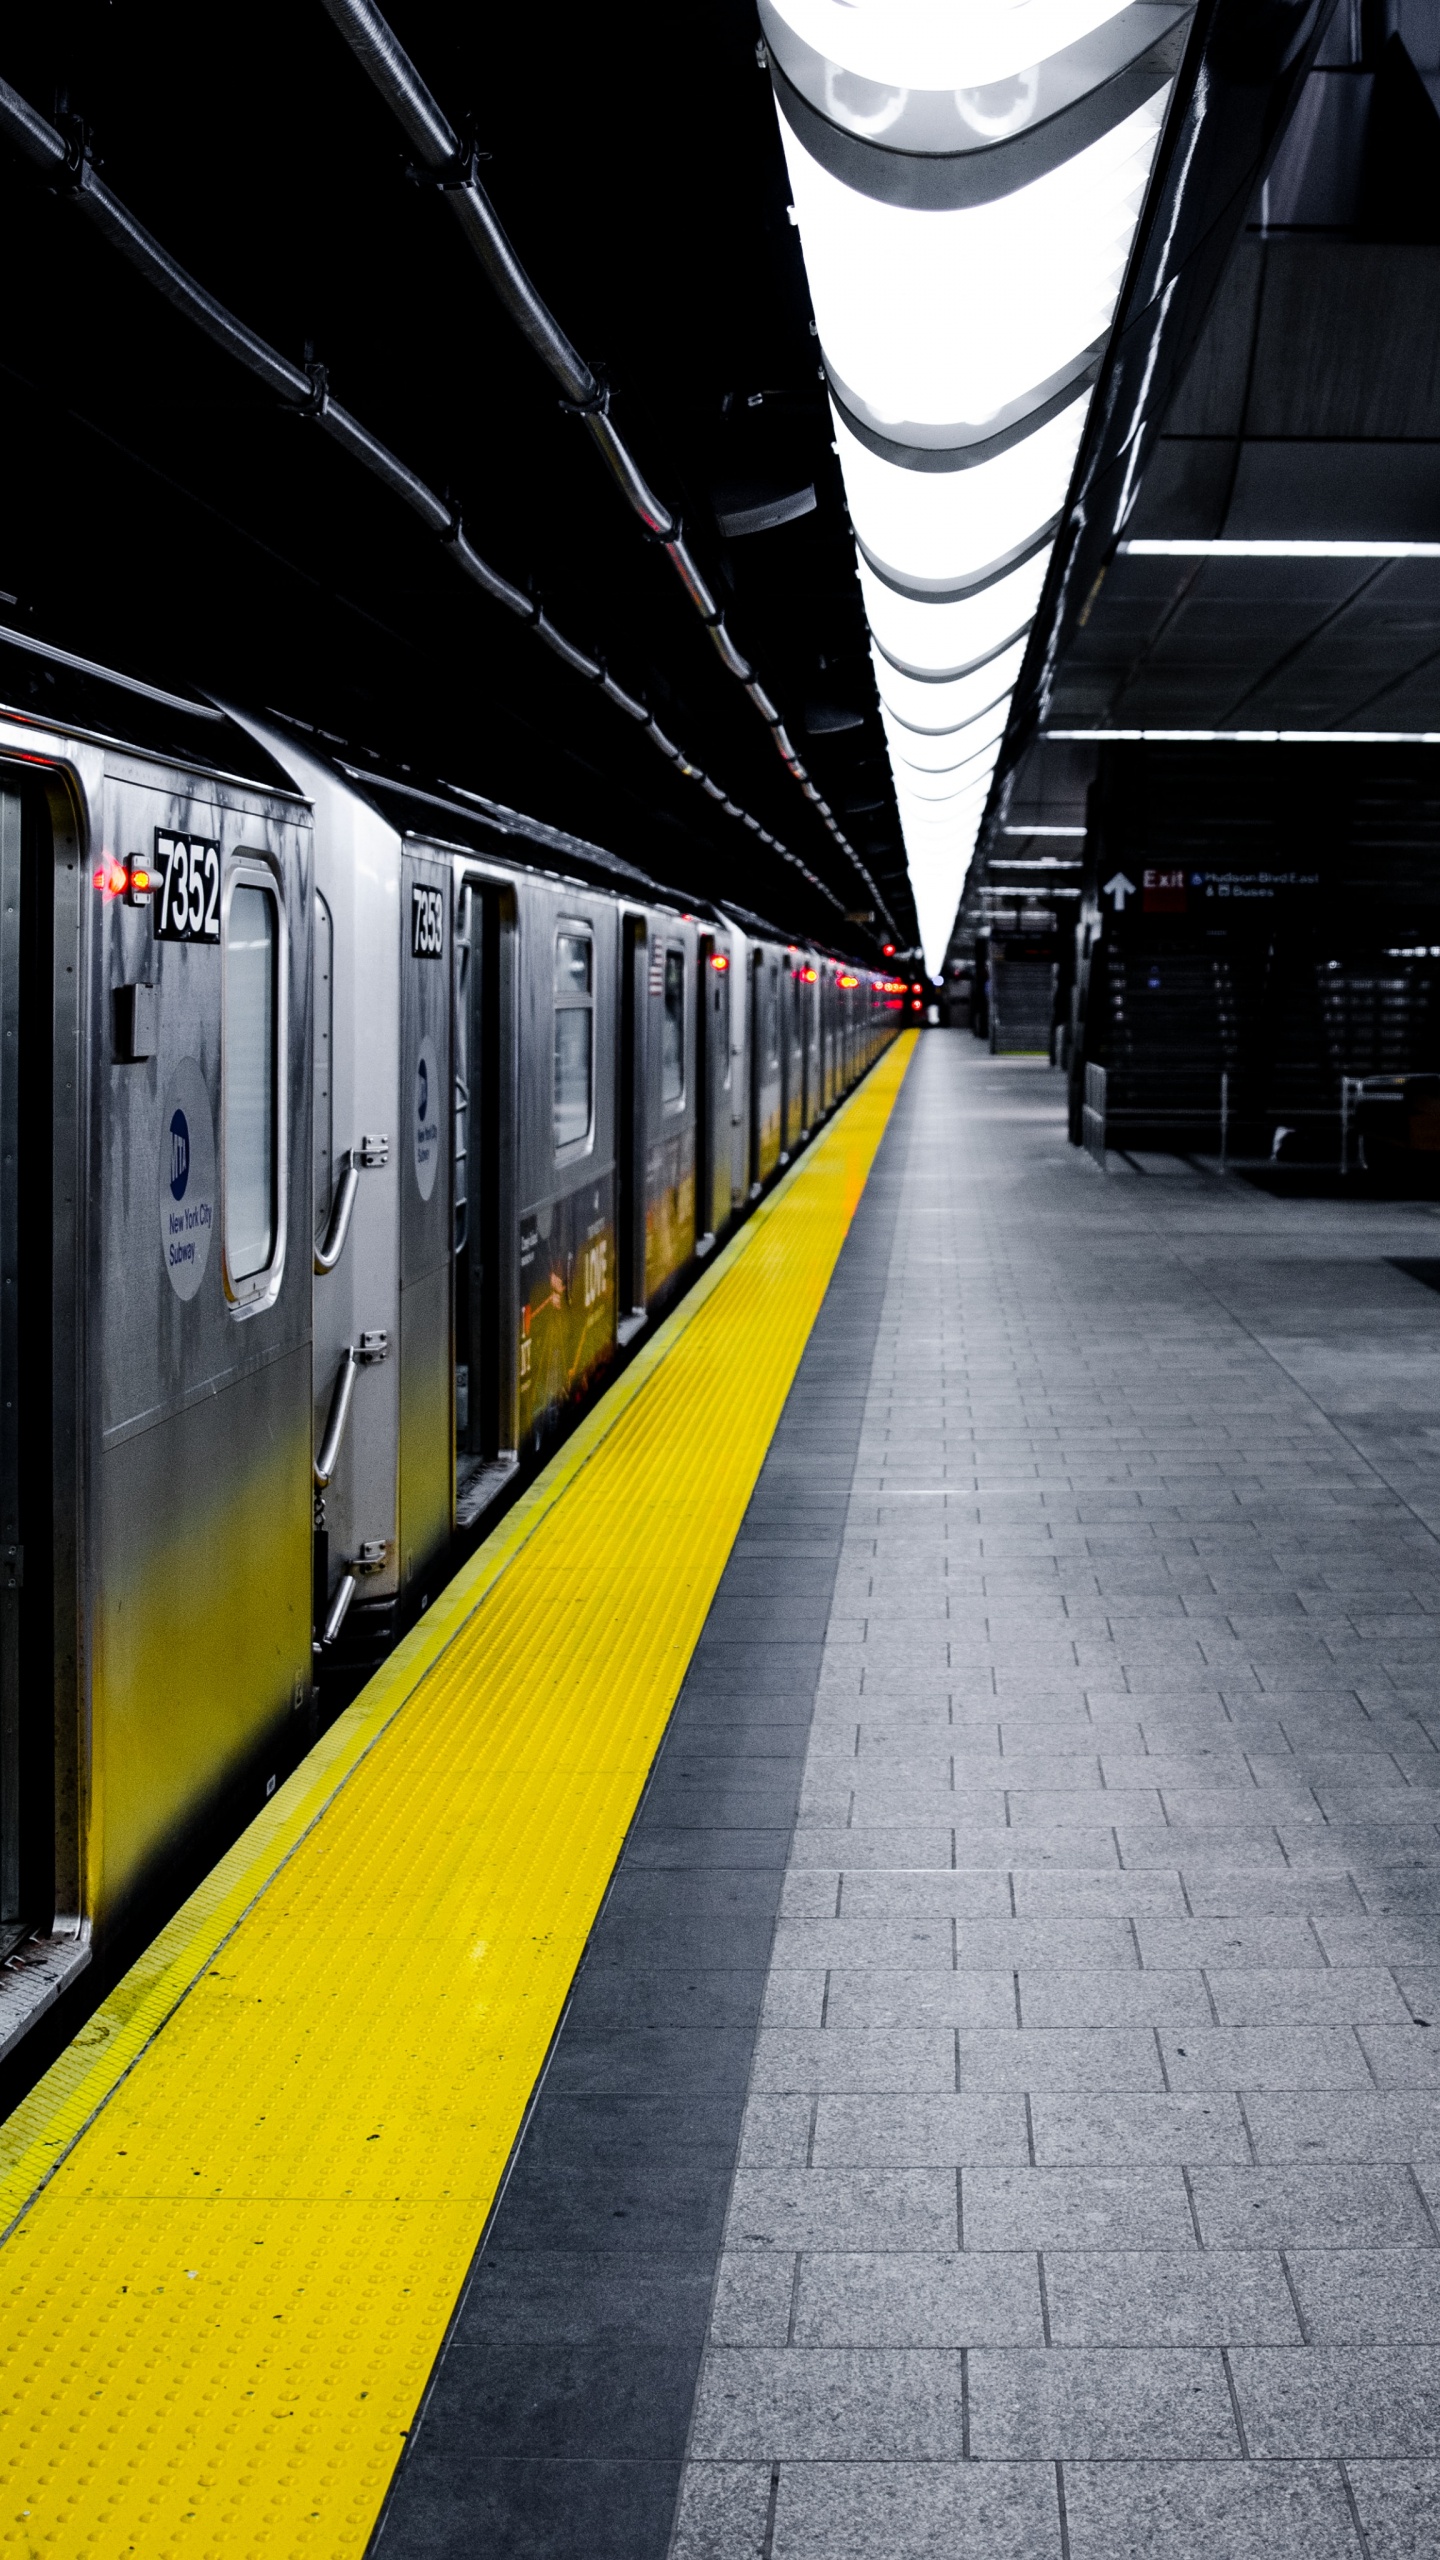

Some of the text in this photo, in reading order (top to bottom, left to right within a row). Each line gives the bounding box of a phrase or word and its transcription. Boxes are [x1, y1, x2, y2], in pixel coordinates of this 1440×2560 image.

[158, 838, 219, 932] 7352
[1143, 870, 1319, 888] Exit Hudson Blvd East
[1233, 887, 1274, 897] Buses
[413, 888, 443, 952] 7353
[170, 1133, 188, 1182] MTA
[169, 1203, 212, 1235] New York City
[169, 1242, 195, 1266] Subway
